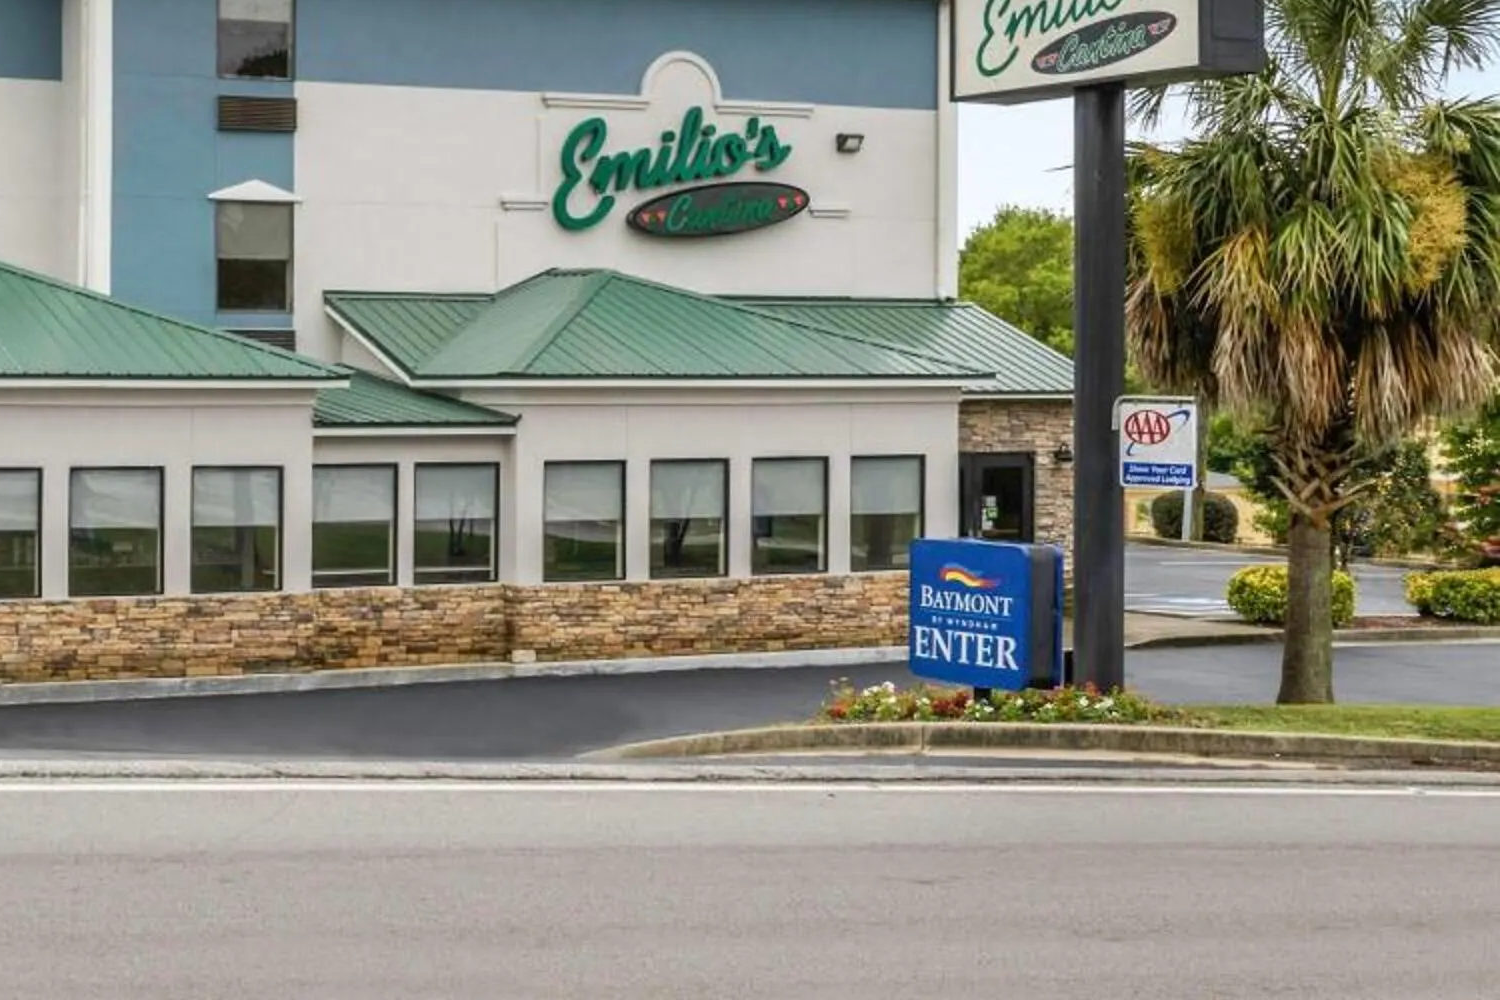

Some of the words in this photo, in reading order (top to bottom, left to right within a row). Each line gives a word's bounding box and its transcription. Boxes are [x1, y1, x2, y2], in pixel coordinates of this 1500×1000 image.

[552, 105, 792, 231] Emilio's
[1127, 410, 1168, 444] AAA
[919, 584, 1012, 617] BAYMONT
[931, 615, 943, 624] BY
[947, 617, 998, 630] WYNDHAM
[914, 625, 1019, 670] ENTER
